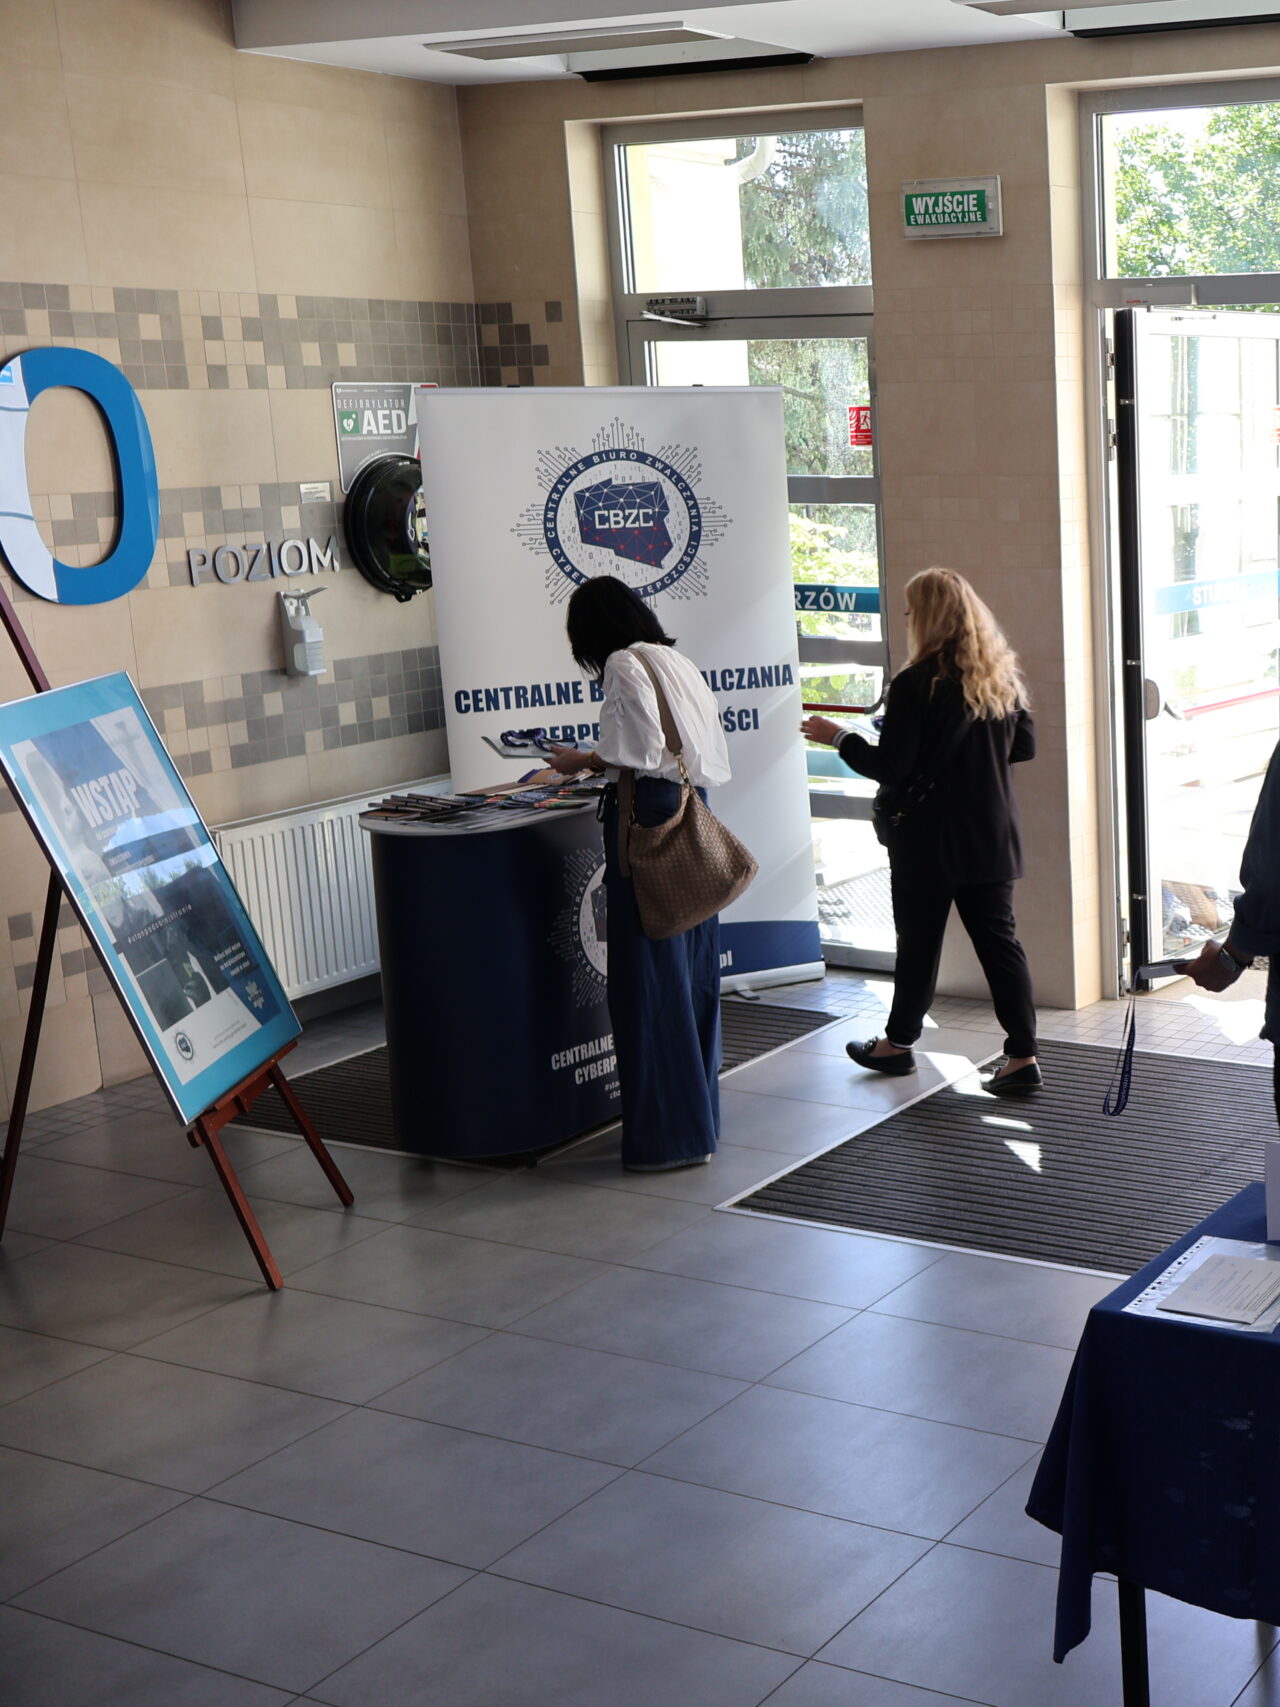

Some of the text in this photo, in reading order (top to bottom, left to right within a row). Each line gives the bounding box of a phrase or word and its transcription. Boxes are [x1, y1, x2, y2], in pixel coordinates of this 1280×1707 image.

[912, 192, 978, 214] WYJŚCIE
[910, 211, 982, 225] EWAKUACYJNE
[337, 398, 405, 409] DEFIBRYLATOR
[362, 409, 407, 435] AED
[546, 451, 699, 538] CENTRALNE BIURO ZWALCZANIA
[594, 508, 654, 530] CBZC
[188, 536, 340, 588] POZIOM
[794, 590, 857, 611] RZÓW
[701, 664, 794, 692] ALCZANIA
[454, 680, 584, 714] CENTRALNE
[577, 950, 608, 986] CYBER
[551, 1033, 614, 1070] CENTRALNE
[575, 1054, 618, 1085] CYBERP
[604, 1081, 620, 1091] #sta
